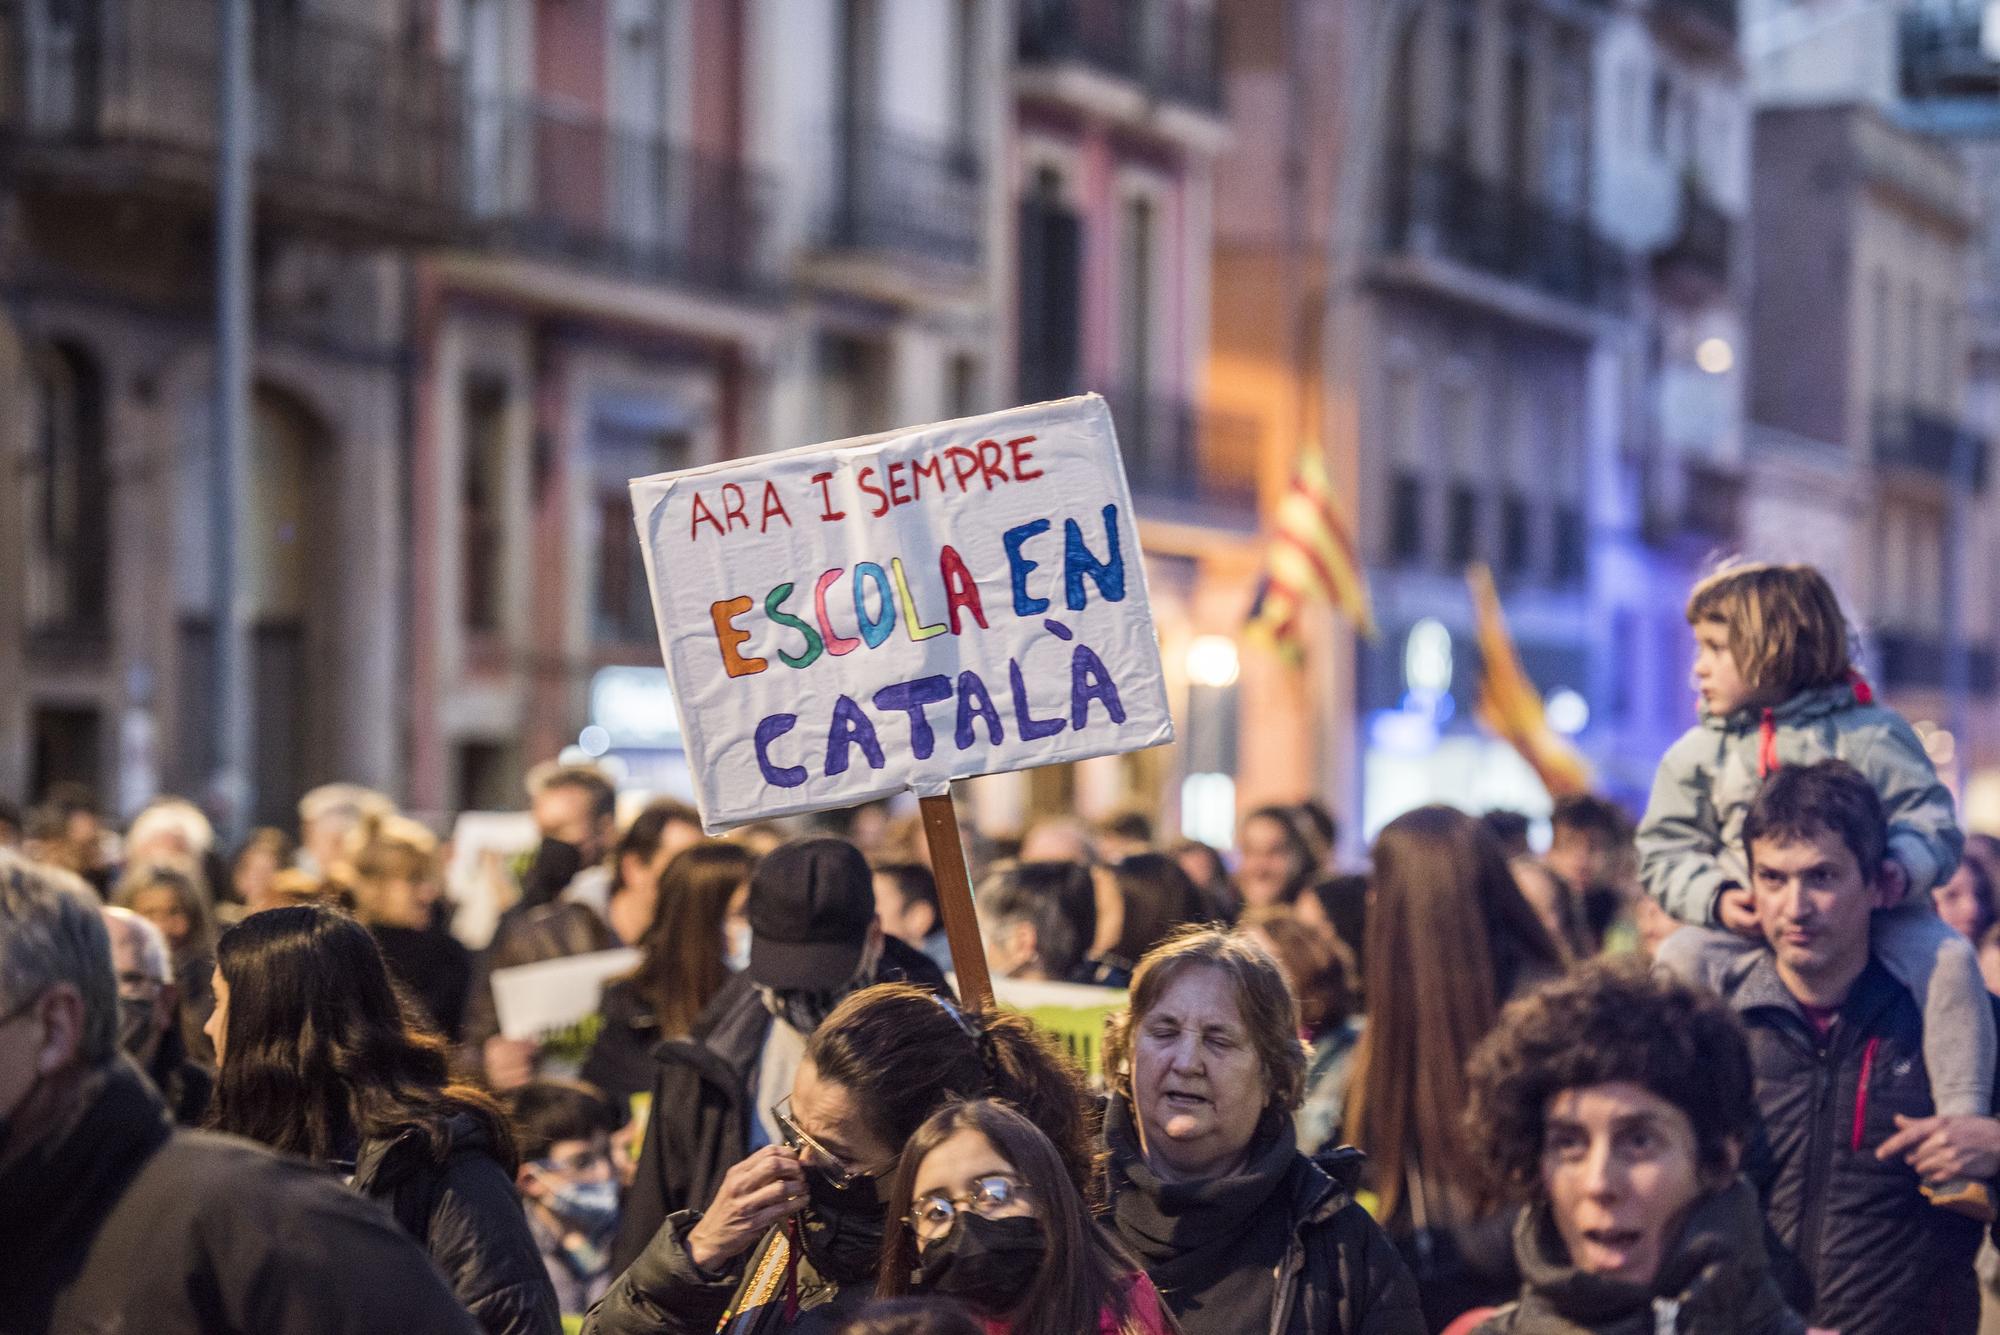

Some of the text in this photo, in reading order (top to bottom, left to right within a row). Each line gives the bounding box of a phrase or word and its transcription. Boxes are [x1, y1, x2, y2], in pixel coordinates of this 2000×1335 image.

[691, 435, 1044, 541] ARA I SEMPRE
[711, 504, 1125, 678] ESCOLA EN
[754, 619, 1126, 788] CATALÀ
